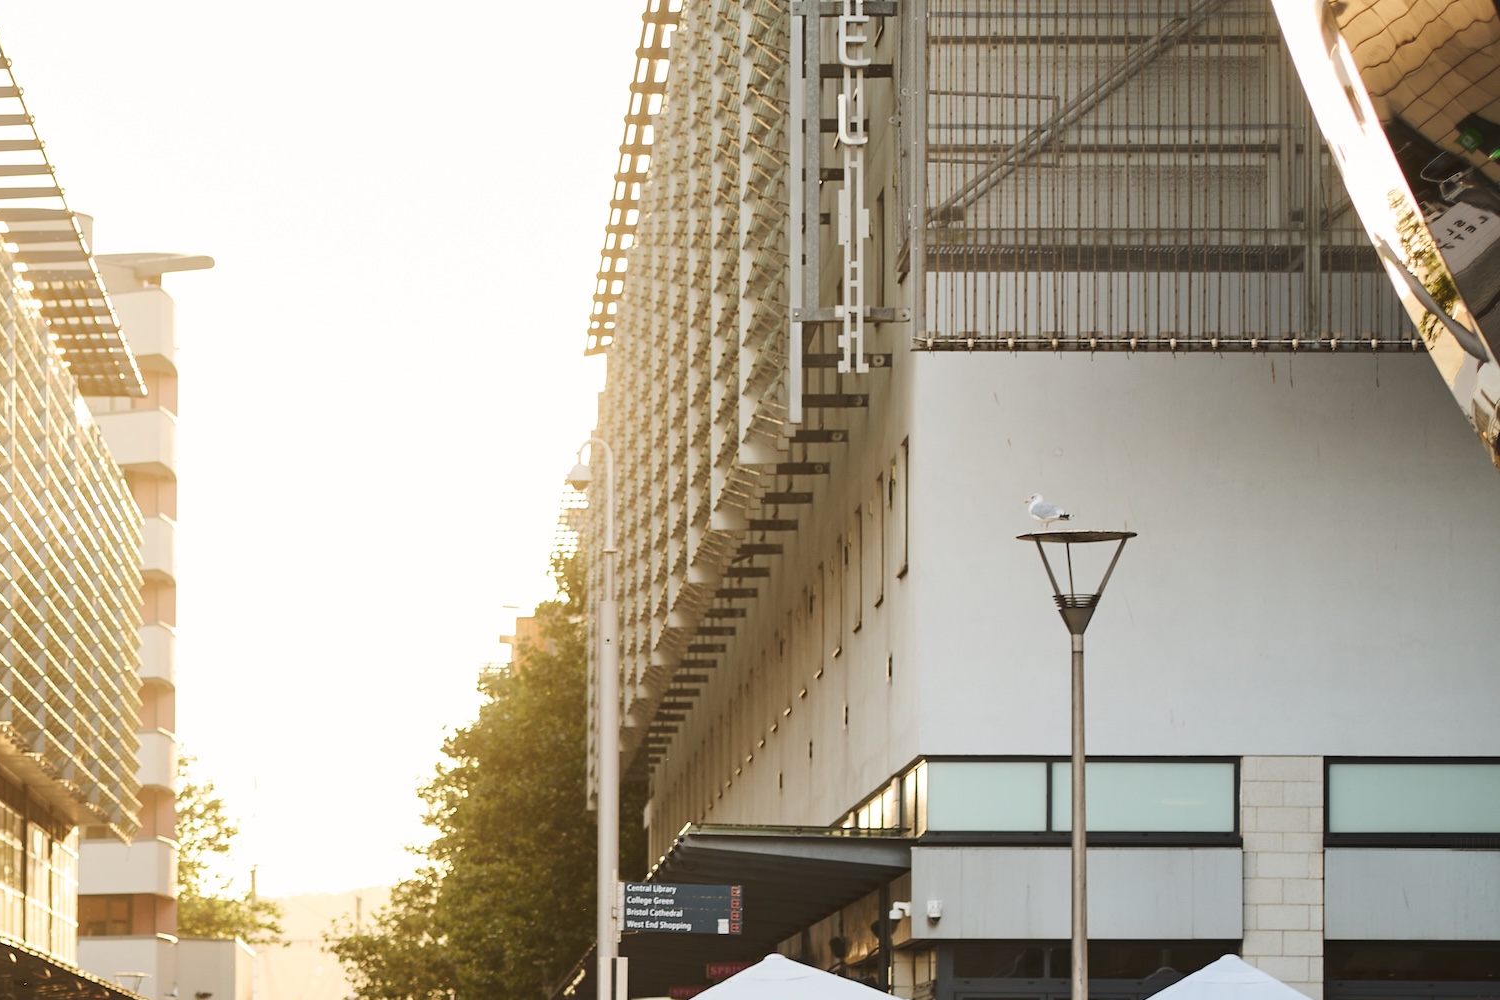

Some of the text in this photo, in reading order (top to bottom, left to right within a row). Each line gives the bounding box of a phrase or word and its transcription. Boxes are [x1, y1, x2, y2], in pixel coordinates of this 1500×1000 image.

[626, 884, 677, 895] Central Library
[626, 896, 675, 906] College Green
[626, 908, 683, 917] Bristol Cathedral
[626, 920, 692, 931] West End Shopping
